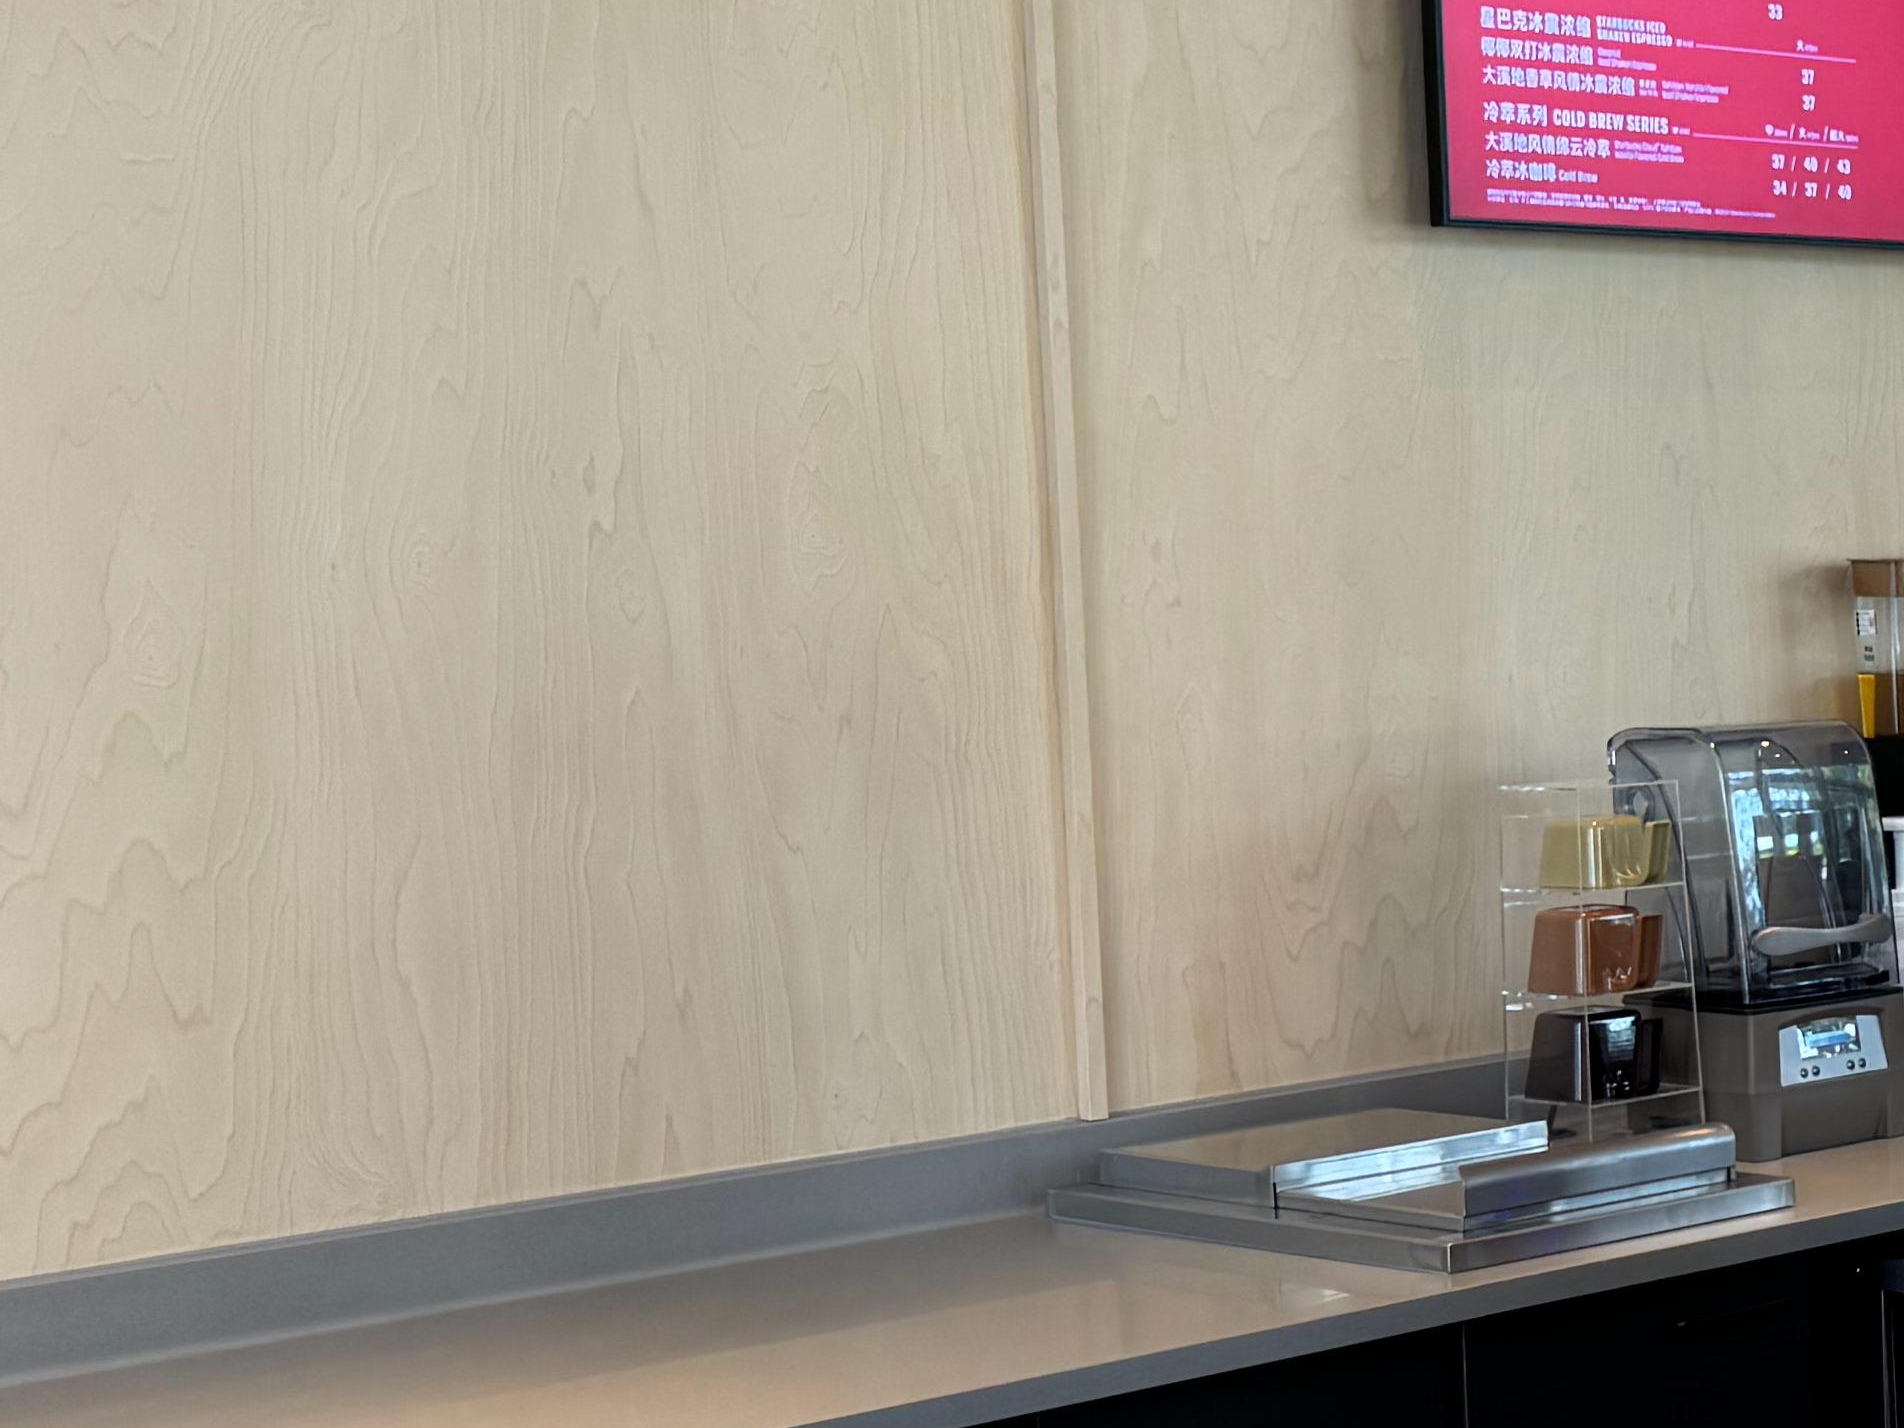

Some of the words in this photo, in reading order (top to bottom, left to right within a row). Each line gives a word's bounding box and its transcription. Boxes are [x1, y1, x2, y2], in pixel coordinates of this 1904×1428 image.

[1483, 101, 1548, 127] 冷萃系列
[1553, 109, 1586, 128] COLD
[1589, 112, 1624, 131] BREW
[1627, 114, 1669, 135] SERIES
[1486, 159, 1556, 182] 冷萃冰咖啡
